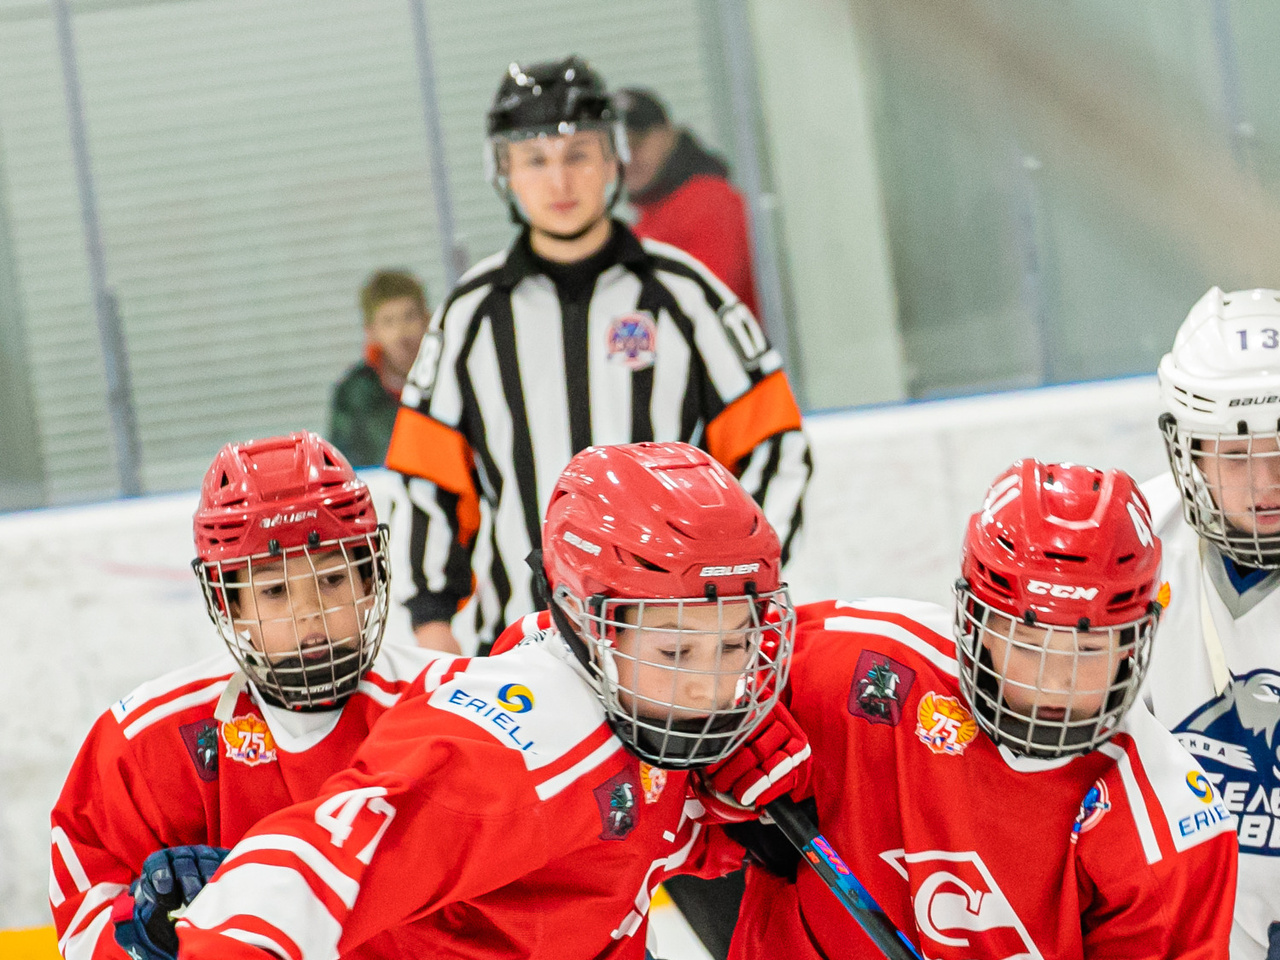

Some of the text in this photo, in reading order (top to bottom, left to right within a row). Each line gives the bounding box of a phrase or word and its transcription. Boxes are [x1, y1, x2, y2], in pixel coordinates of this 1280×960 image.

[1236, 328, 1280, 351] 13
[699, 563, 760, 577] BAUER
[1026, 579, 1100, 601] CCM
[928, 711, 963, 744] 75
[238, 731, 266, 754] 75
[315, 786, 397, 867] 47
